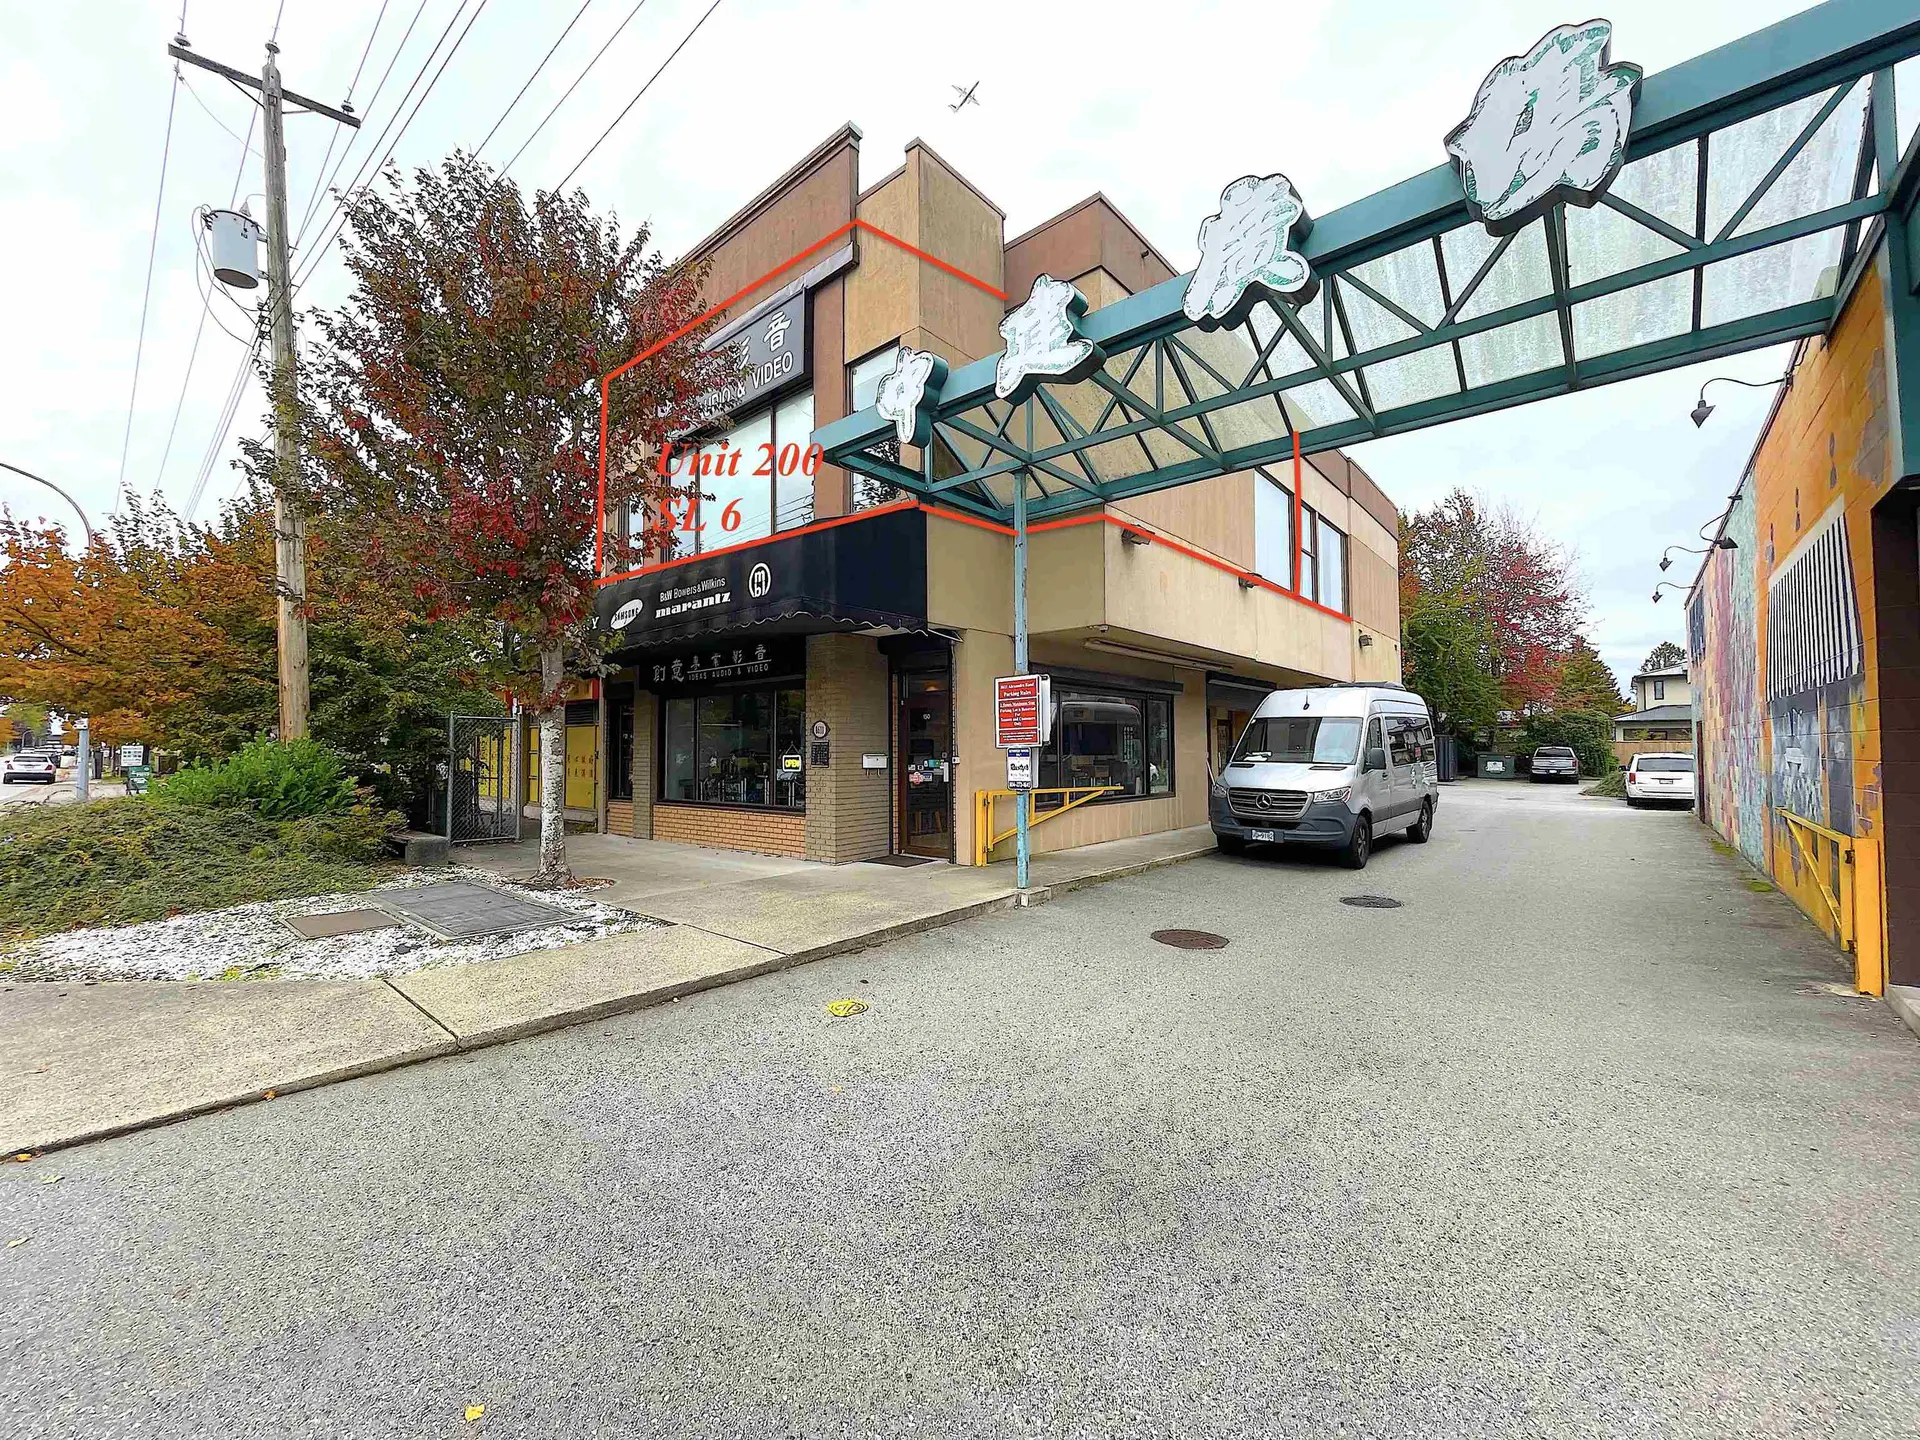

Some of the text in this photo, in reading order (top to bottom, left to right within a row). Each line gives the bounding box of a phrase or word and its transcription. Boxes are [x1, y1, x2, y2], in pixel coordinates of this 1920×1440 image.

[751, 350, 794, 390] VIDEO
[654, 591, 731, 619] marantz
[688, 672, 707, 681] IDEAS
[711, 668, 732, 678] AUDIO
[746, 663, 769, 673] VIDEO
[785, 759, 801, 769] OPEN
